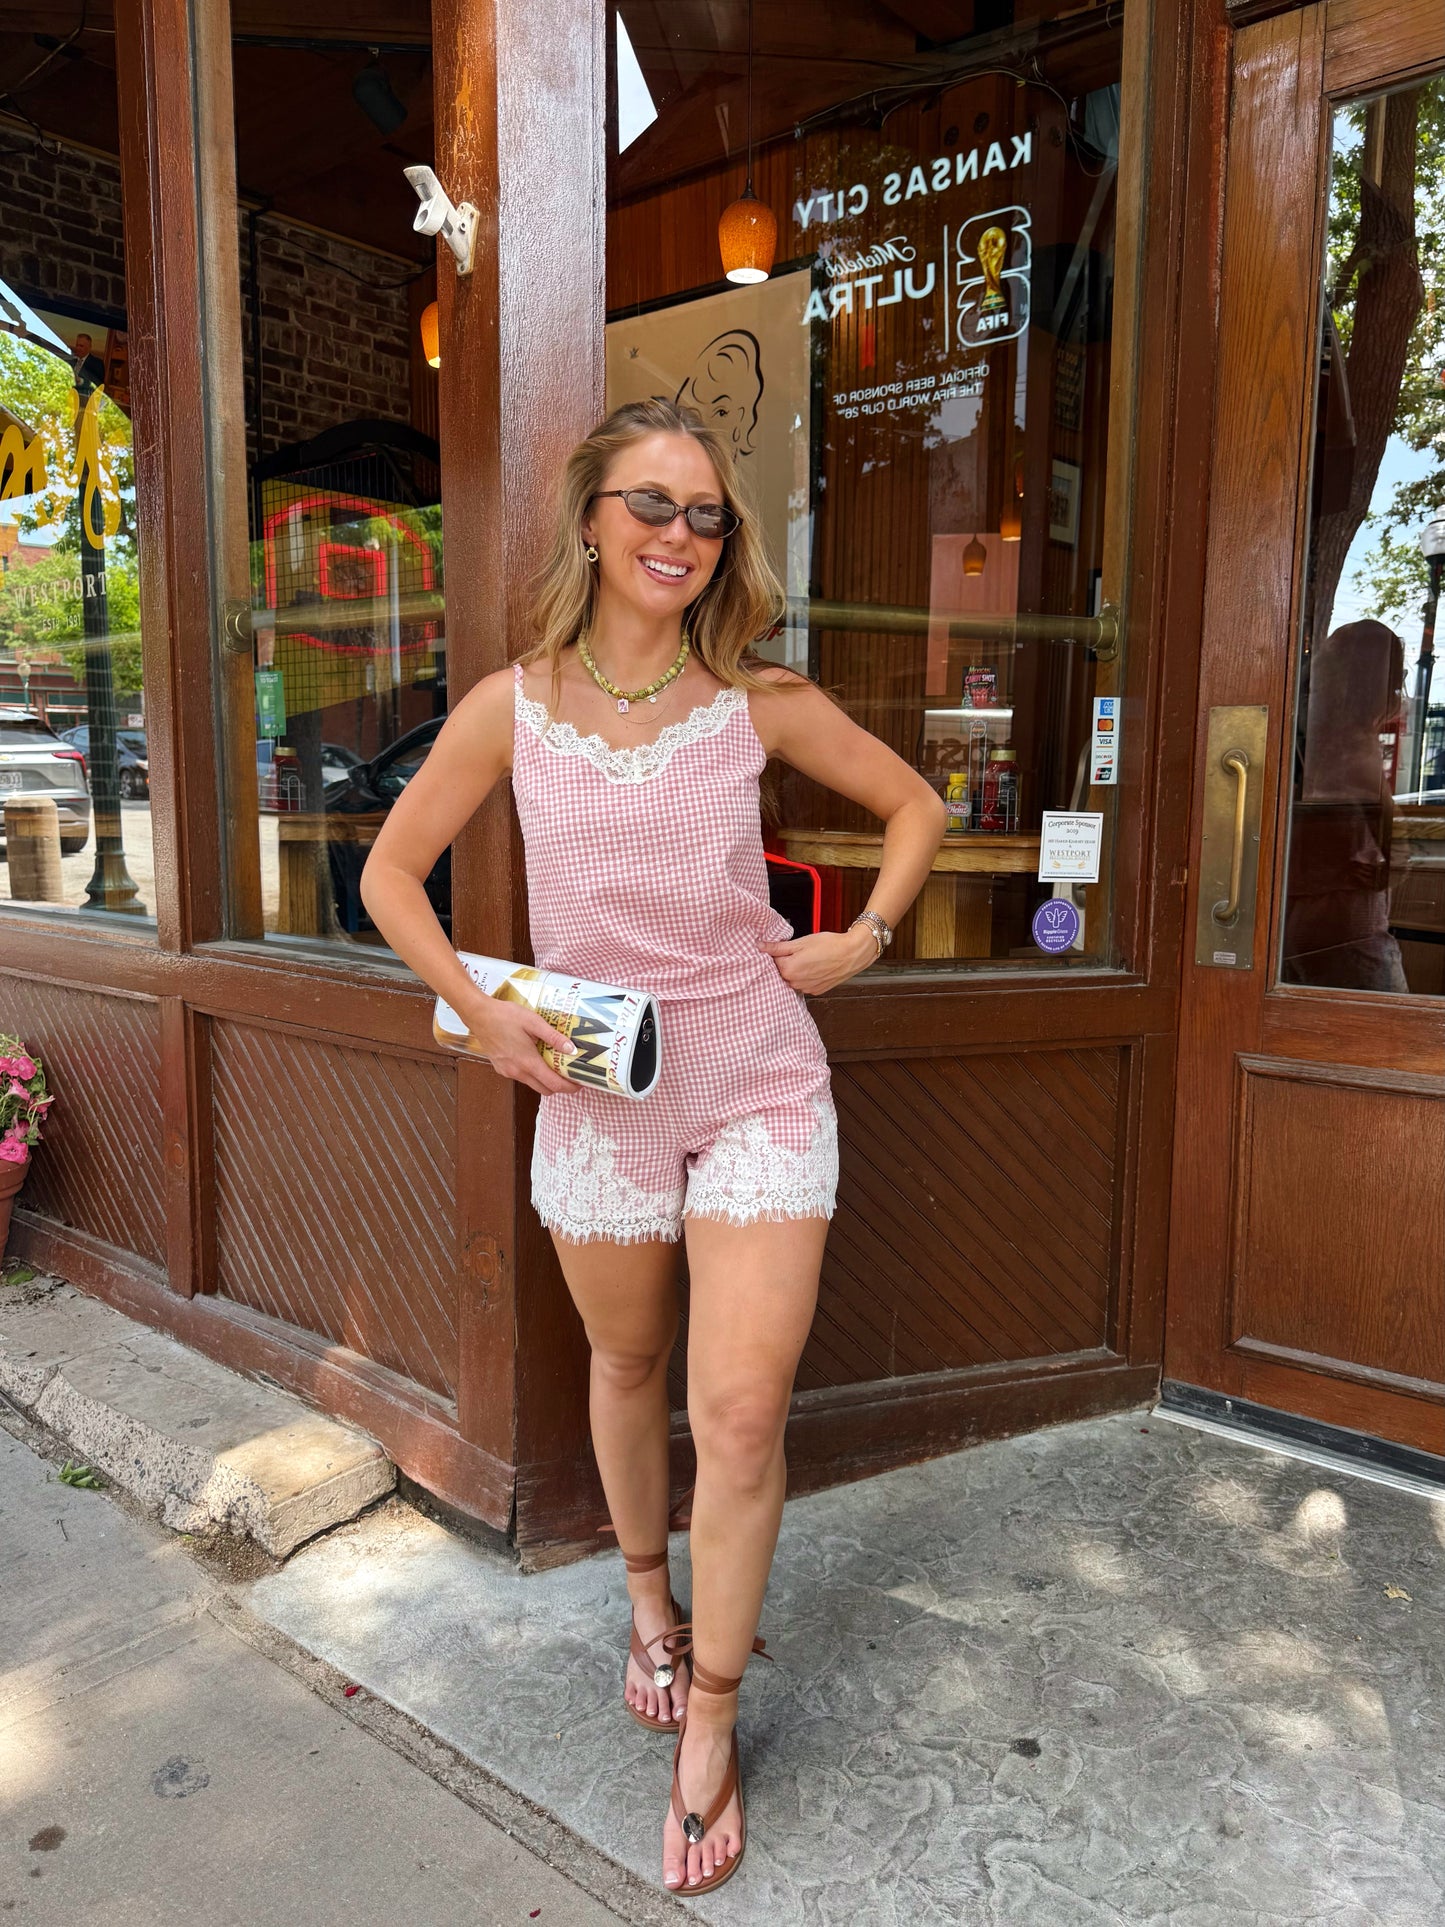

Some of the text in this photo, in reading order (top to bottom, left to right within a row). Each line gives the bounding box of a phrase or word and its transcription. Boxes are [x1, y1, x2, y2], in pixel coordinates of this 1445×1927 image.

[15, 571, 108, 609] WESTPORT
[1048, 819, 1097, 829] Corporate Sponsor
[1049, 849, 1091, 857] WESTPORT
[608, 1030, 628, 1086] Secret
